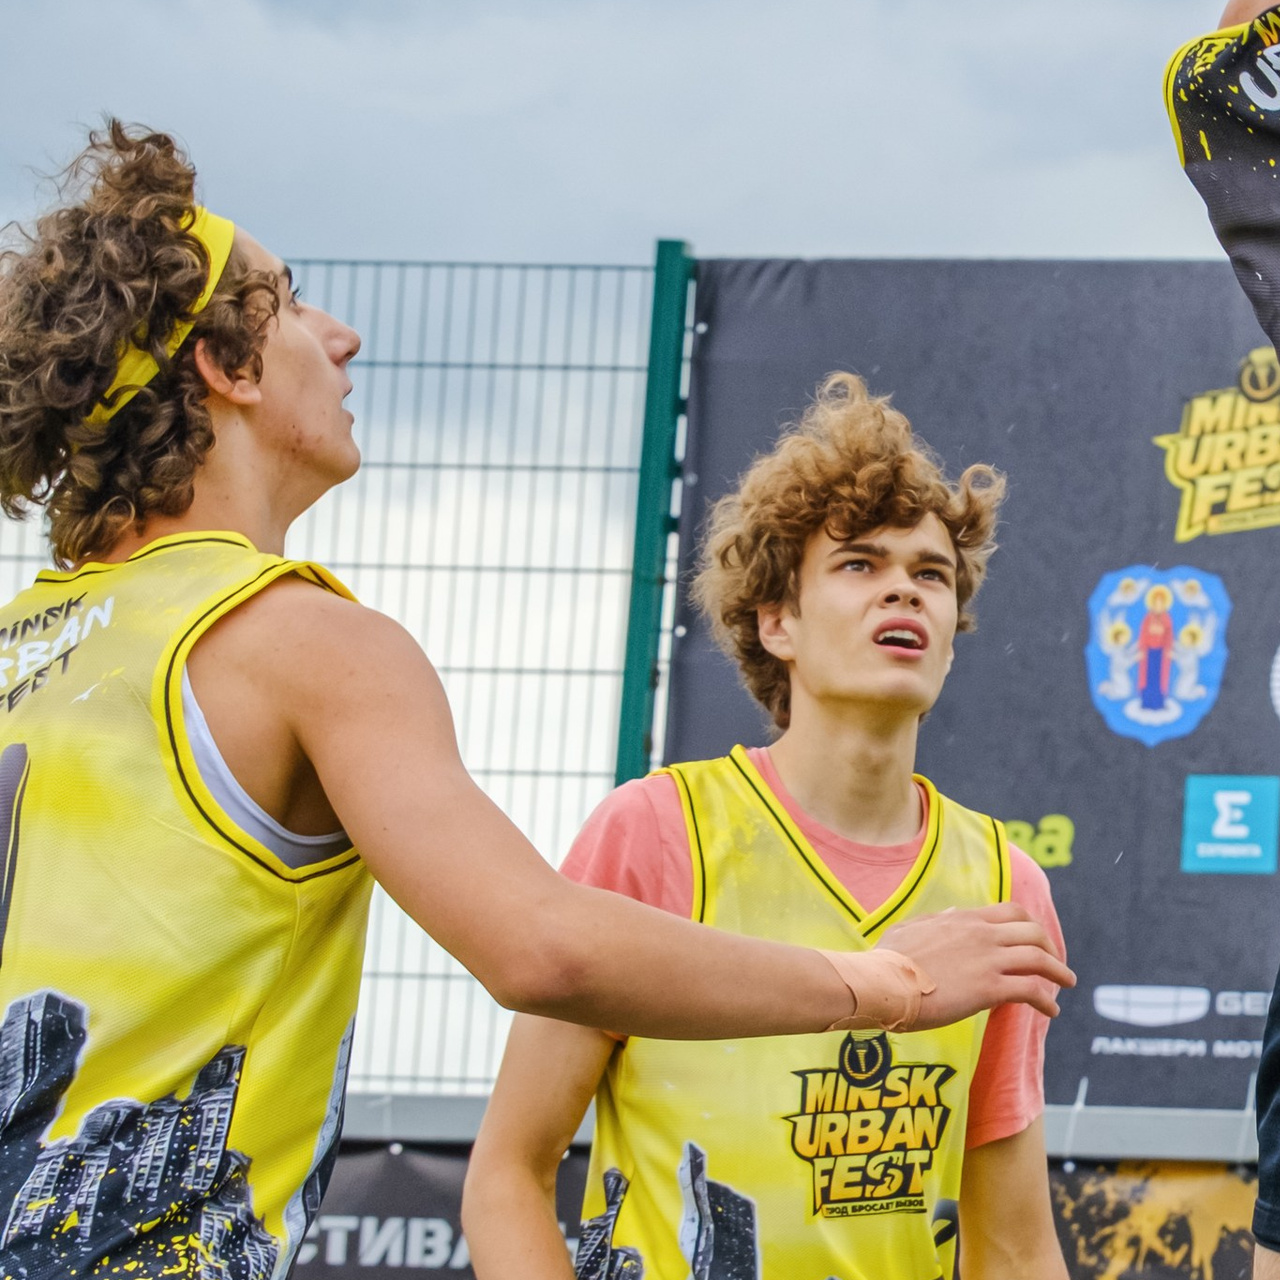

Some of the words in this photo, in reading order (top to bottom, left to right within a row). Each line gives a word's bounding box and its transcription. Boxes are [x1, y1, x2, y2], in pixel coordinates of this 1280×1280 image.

[0, 643, 80, 713] EST
[804, 1066, 949, 1114] MINSK
[786, 1106, 944, 1158] URBAN
[813, 1150, 931, 1211] FEST
